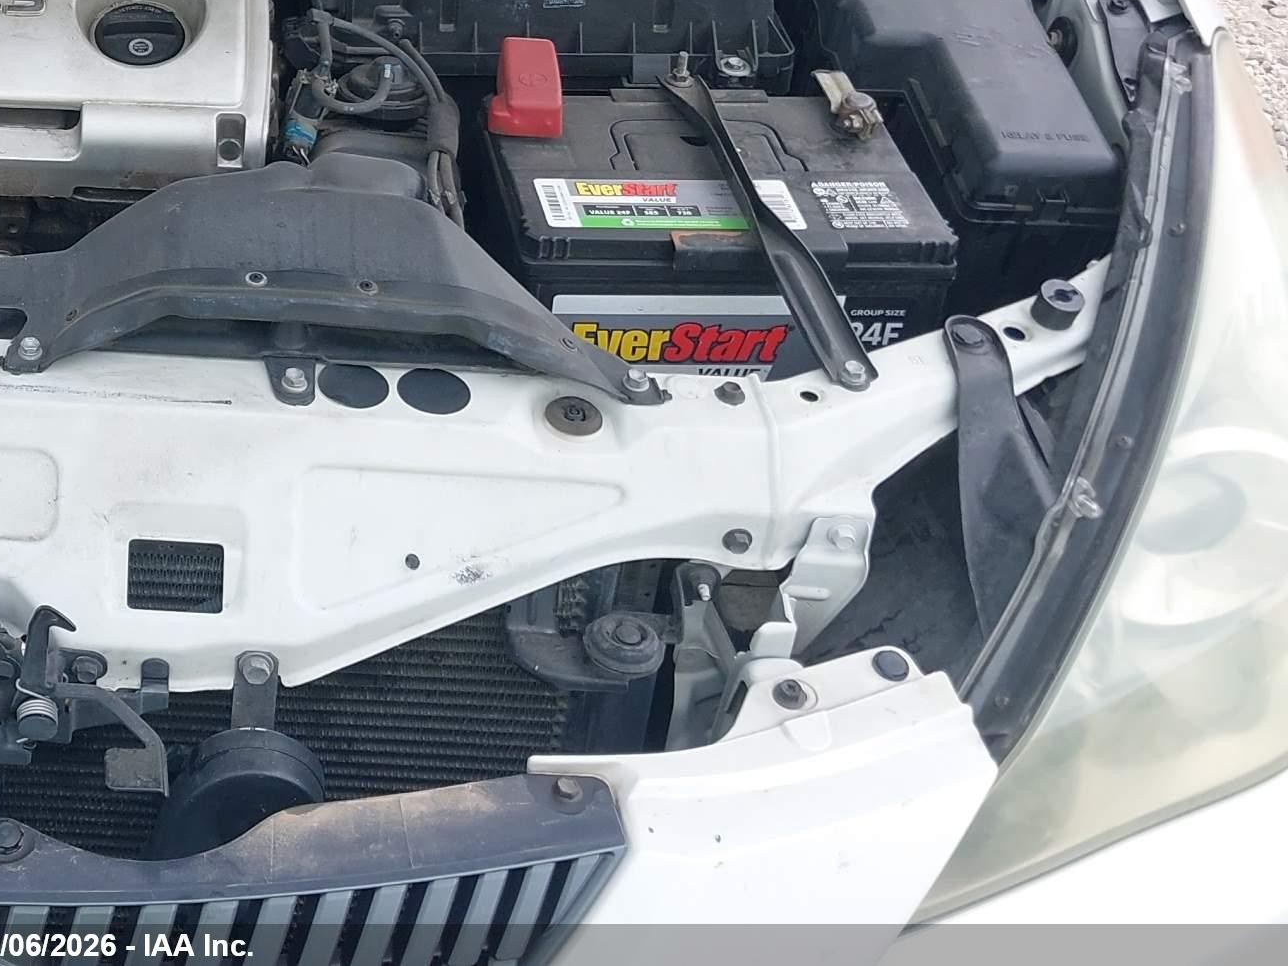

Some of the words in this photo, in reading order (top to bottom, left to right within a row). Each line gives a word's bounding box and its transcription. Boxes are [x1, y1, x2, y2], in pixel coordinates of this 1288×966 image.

[576, 183, 677, 196] EverStart
[850, 309, 884, 317] GROUP
[884, 309, 907, 317] SIZE
